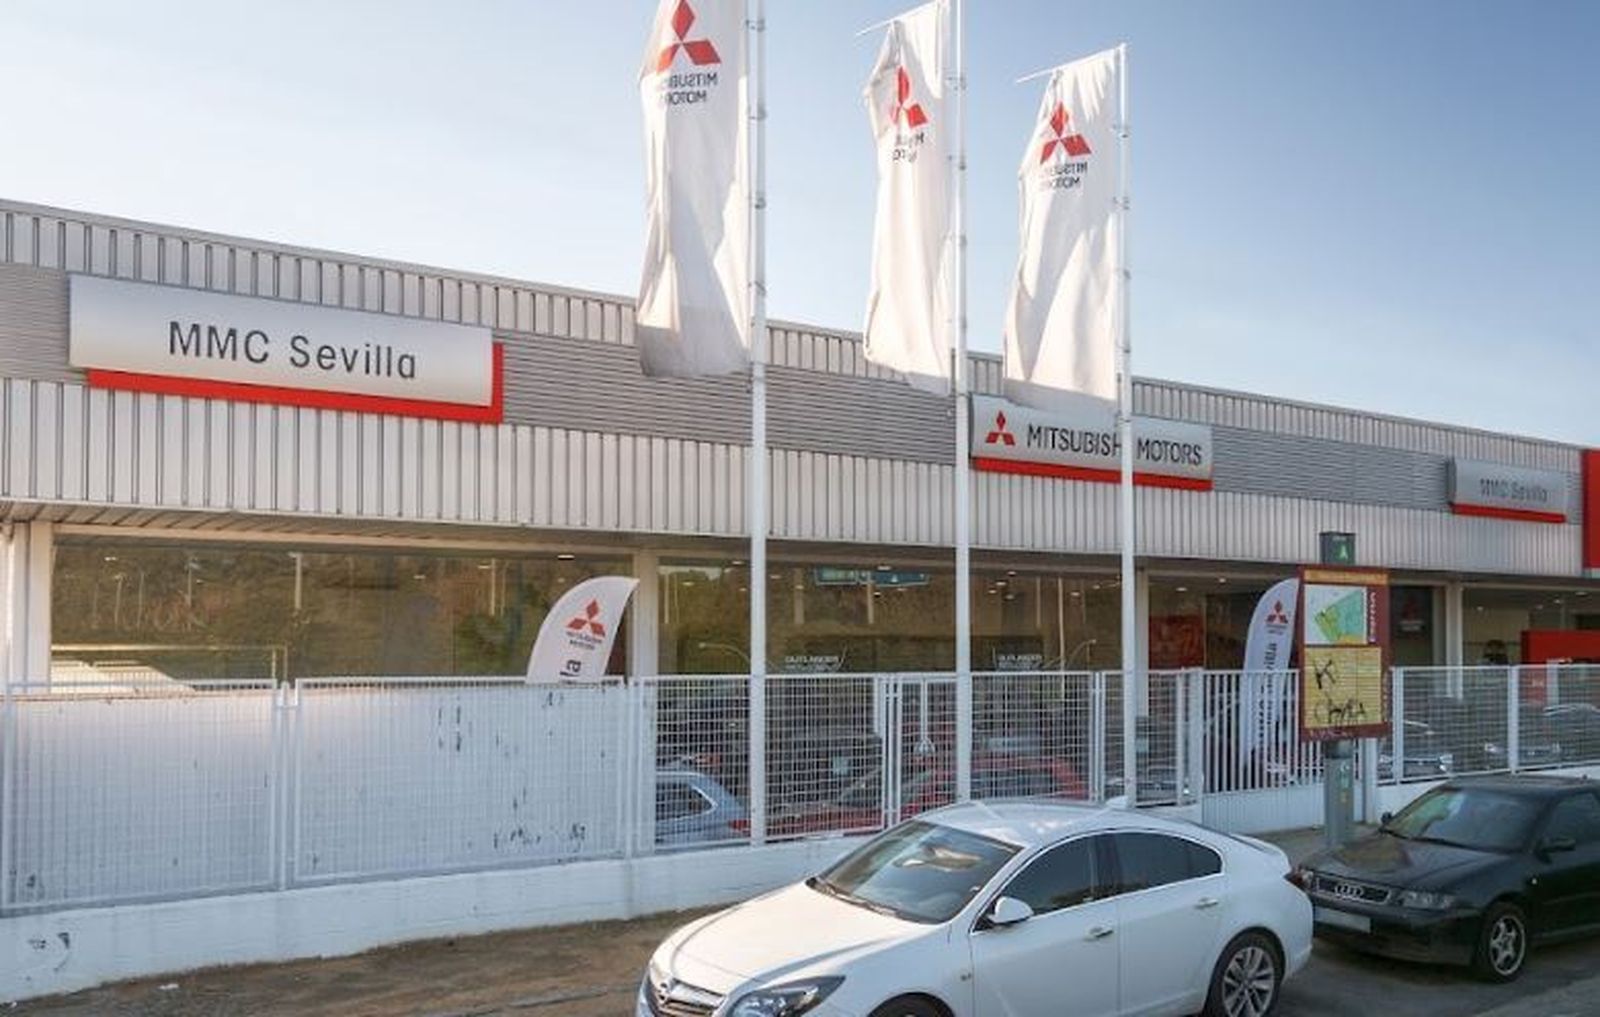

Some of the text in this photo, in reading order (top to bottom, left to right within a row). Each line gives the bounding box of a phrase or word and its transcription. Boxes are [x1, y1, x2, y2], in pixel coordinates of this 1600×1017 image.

[169, 321, 416, 379] MMC Sevilla
[1027, 424, 1202, 466] MITSUBISH MOTORS
